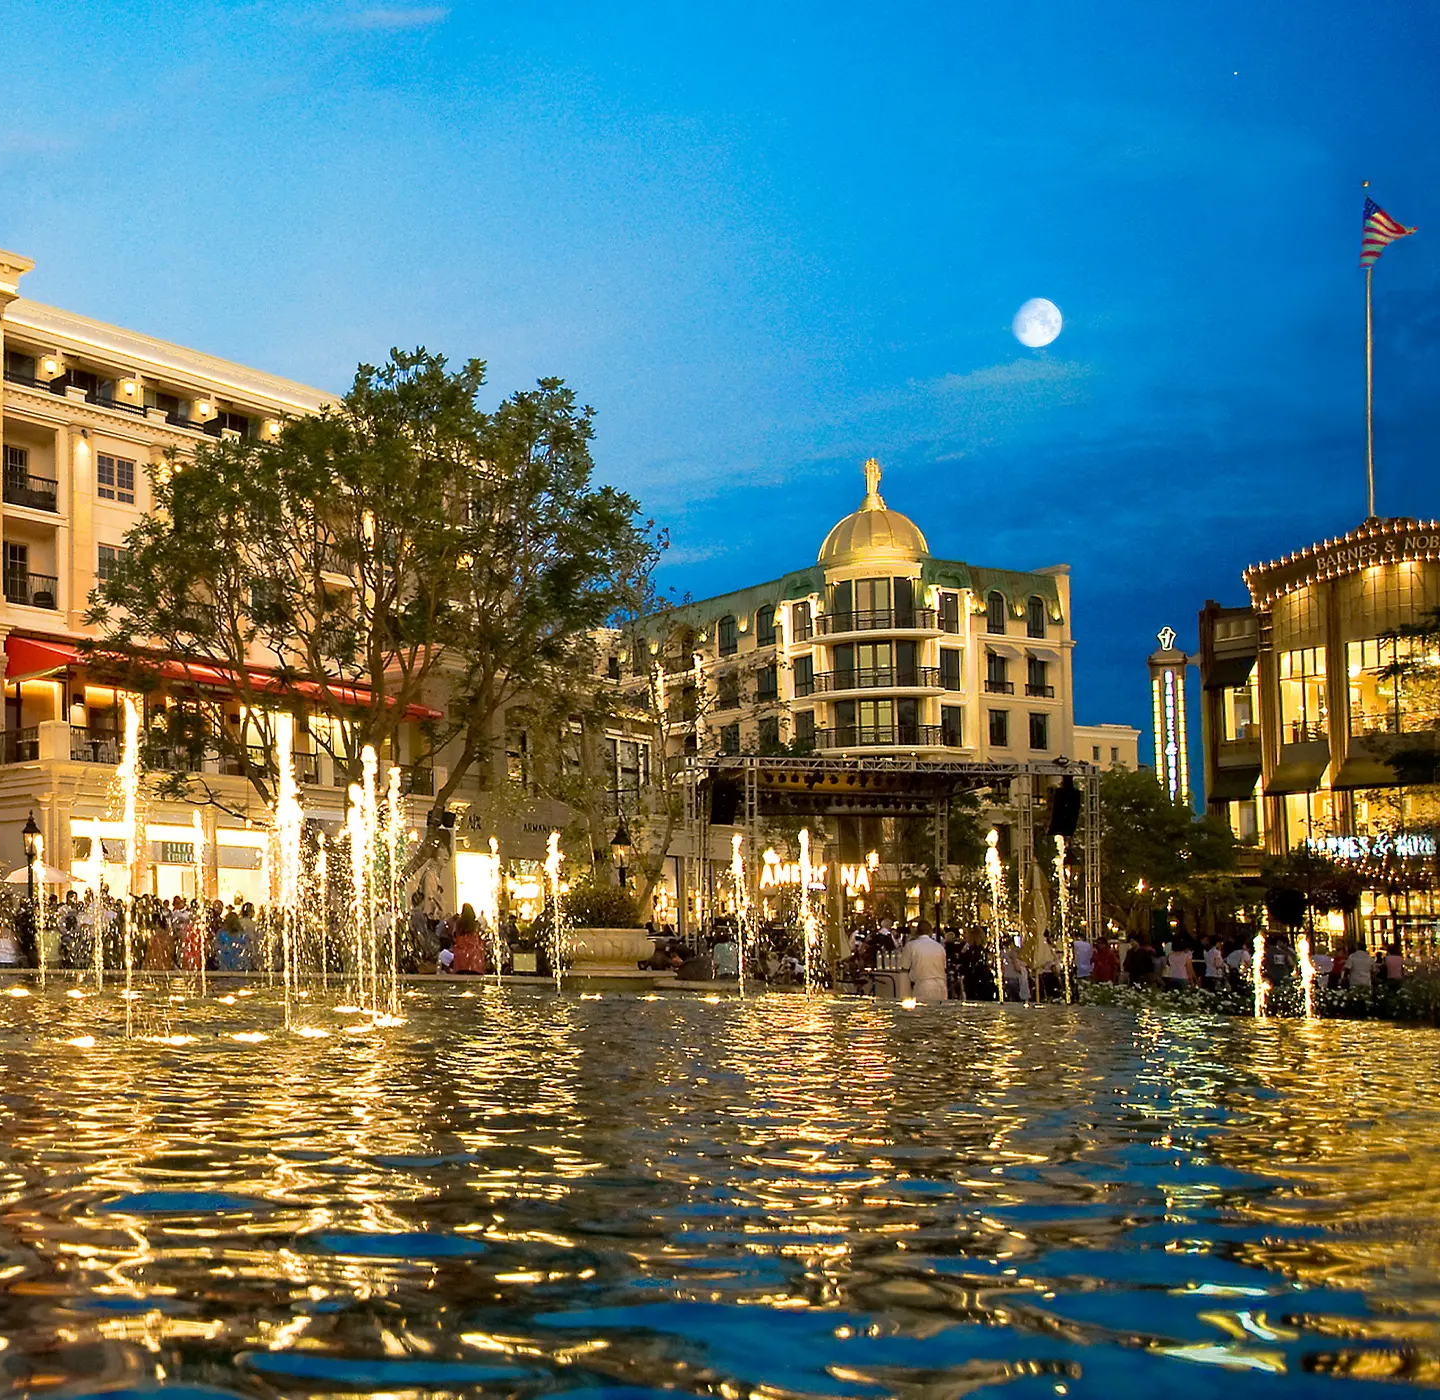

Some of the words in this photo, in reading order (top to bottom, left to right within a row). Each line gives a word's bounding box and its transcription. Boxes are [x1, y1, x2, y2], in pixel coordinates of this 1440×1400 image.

[1316, 541, 1377, 570] BARNES
[1384, 539, 1396, 553] &
[1404, 535, 1440, 550] NOB
[759, 862, 872, 891] AMEICNA
